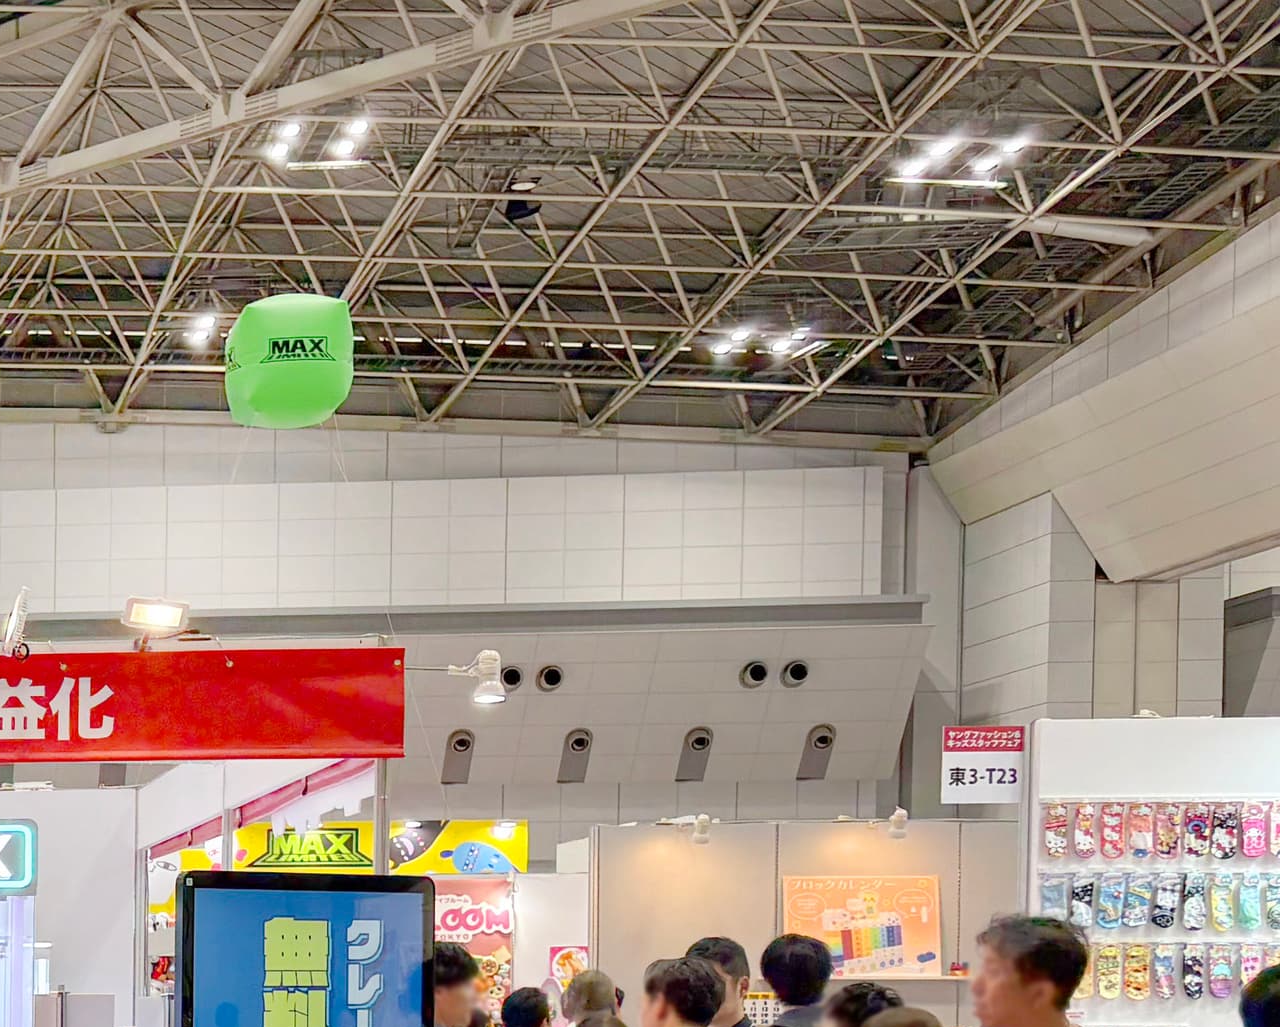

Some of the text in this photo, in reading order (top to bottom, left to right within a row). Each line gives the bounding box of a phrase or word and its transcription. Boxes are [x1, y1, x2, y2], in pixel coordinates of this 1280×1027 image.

[271, 339, 325, 354] MAX
[948, 767, 1018, 786] 東3-T23
[274, 833, 351, 854] MAX
[435, 908, 509, 931] OOM
